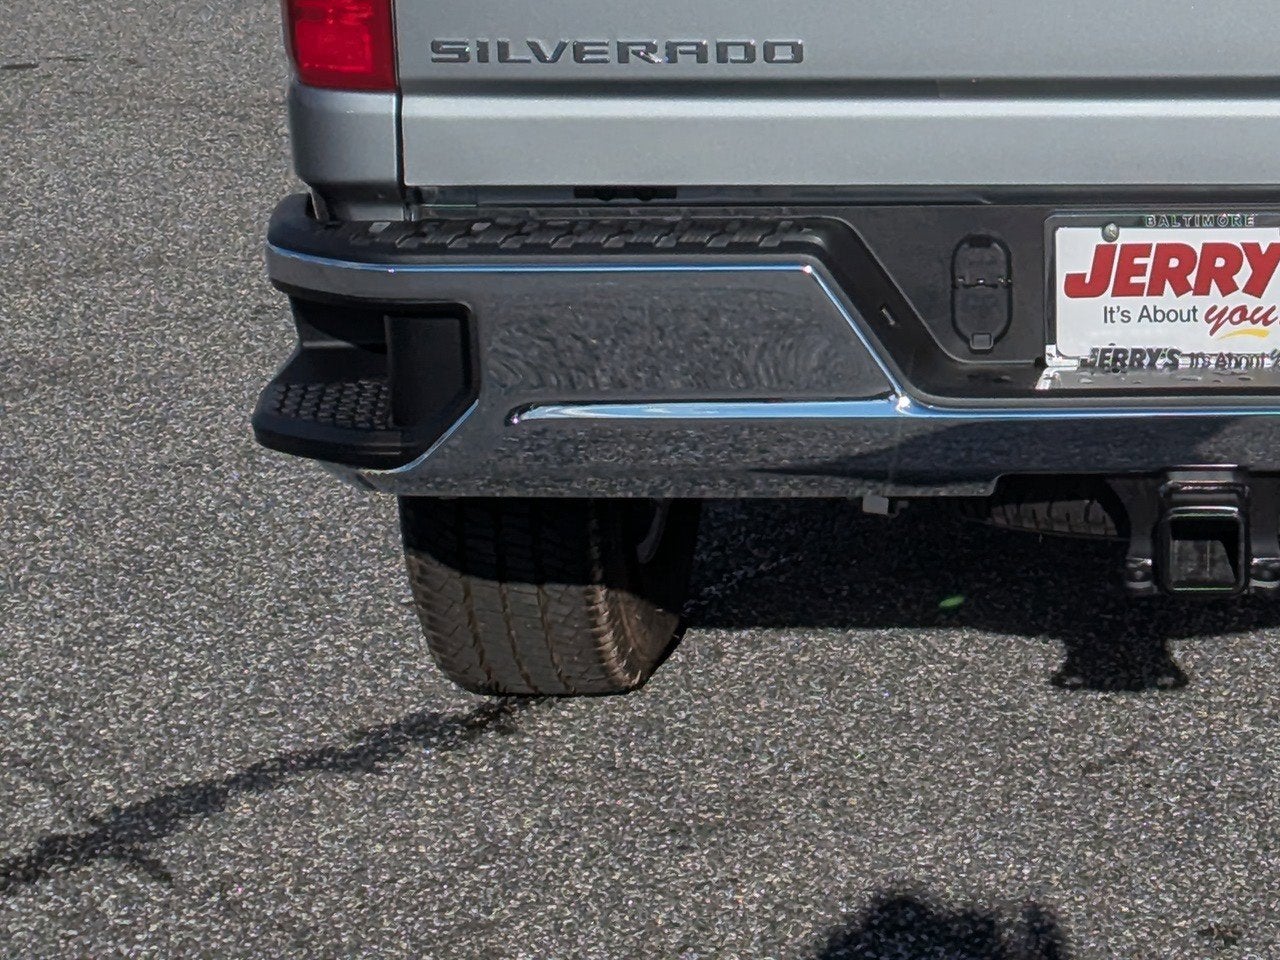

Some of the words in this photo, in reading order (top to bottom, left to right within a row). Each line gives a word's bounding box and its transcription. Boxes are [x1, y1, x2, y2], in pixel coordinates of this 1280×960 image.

[431, 39, 804, 64] SILVERADO
[1145, 213, 1255, 228] BALTIMORE
[1103, 304, 1131, 324] It's
[1137, 304, 1198, 324] About
[1080, 345, 1182, 371] JERRY'S
